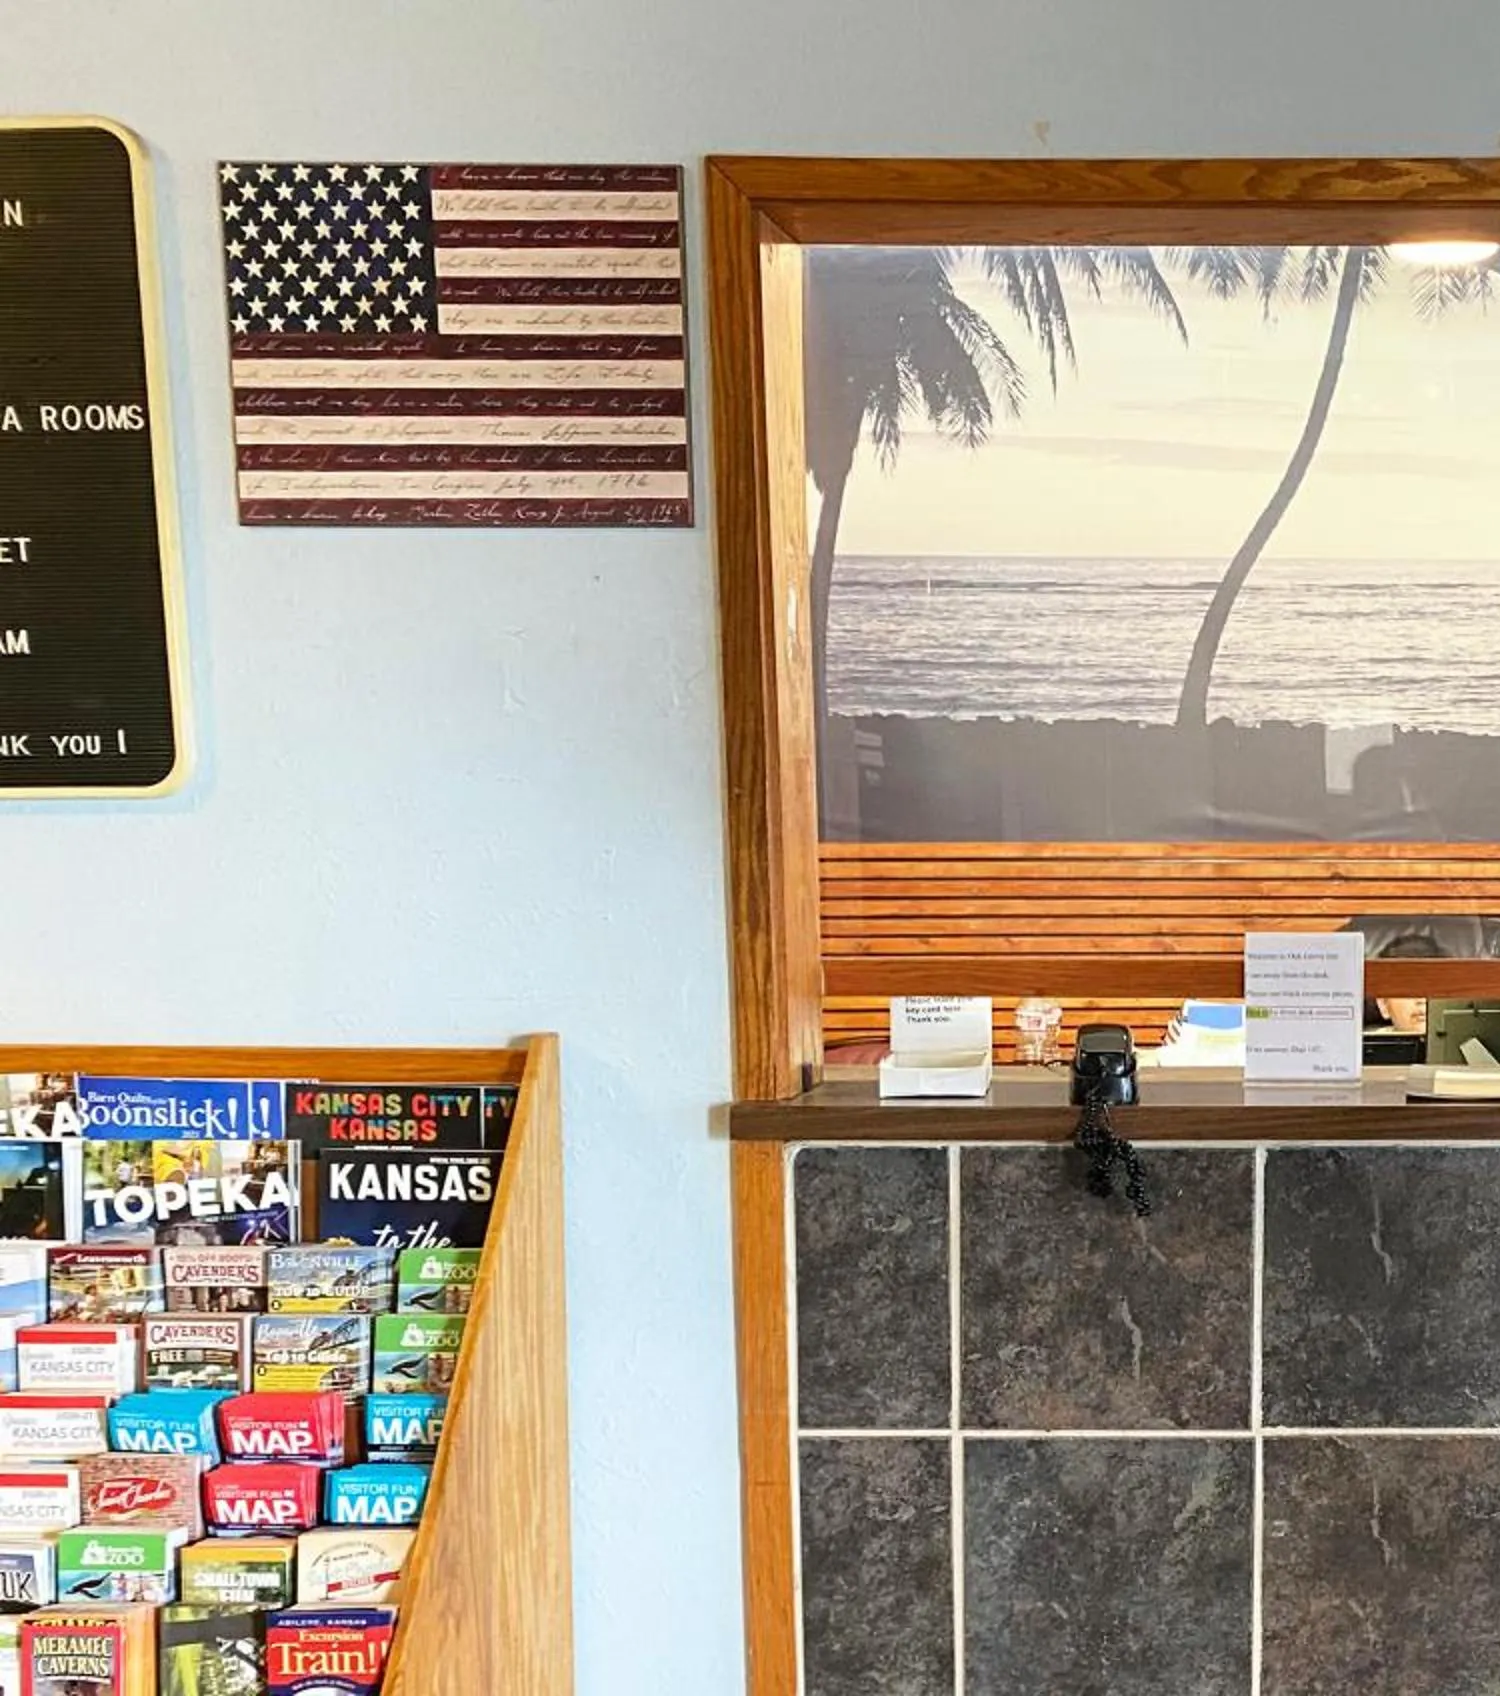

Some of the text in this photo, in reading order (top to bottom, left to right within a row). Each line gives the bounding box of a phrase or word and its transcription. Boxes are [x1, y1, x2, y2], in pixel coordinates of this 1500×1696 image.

[40, 405, 144, 431] ROOMS
[0, 629, 31, 655] M
[50, 735, 101, 756] YOU
[296, 1092, 473, 1117] KANSAS CITY
[330, 1118, 438, 1141] KANSAS
[329, 1163, 492, 1203] KANSAS
[83, 1170, 291, 1227] TOPEKA
[171, 1264, 260, 1284] CAVENDER'S
[150, 1325, 236, 1346] CAVENDER'S
[30, 1361, 116, 1374] KANSAS CITY
[374, 1407, 421, 1417] VISITOR
[12, 1426, 105, 1440] KANSAS CITY
[115, 1417, 196, 1432] VISITOR FUN
[116, 1428, 197, 1453] MAP
[230, 1430, 313, 1455] MAP
[337, 1484, 418, 1495] VISITOR FUN
[36, 1505, 67, 1517] CITY
[215, 1499, 298, 1525] MAP
[336, 1495, 418, 1524] MAP
[33, 1636, 113, 1656] MERAMEC
[37, 1655, 109, 1676] CAVERNS
